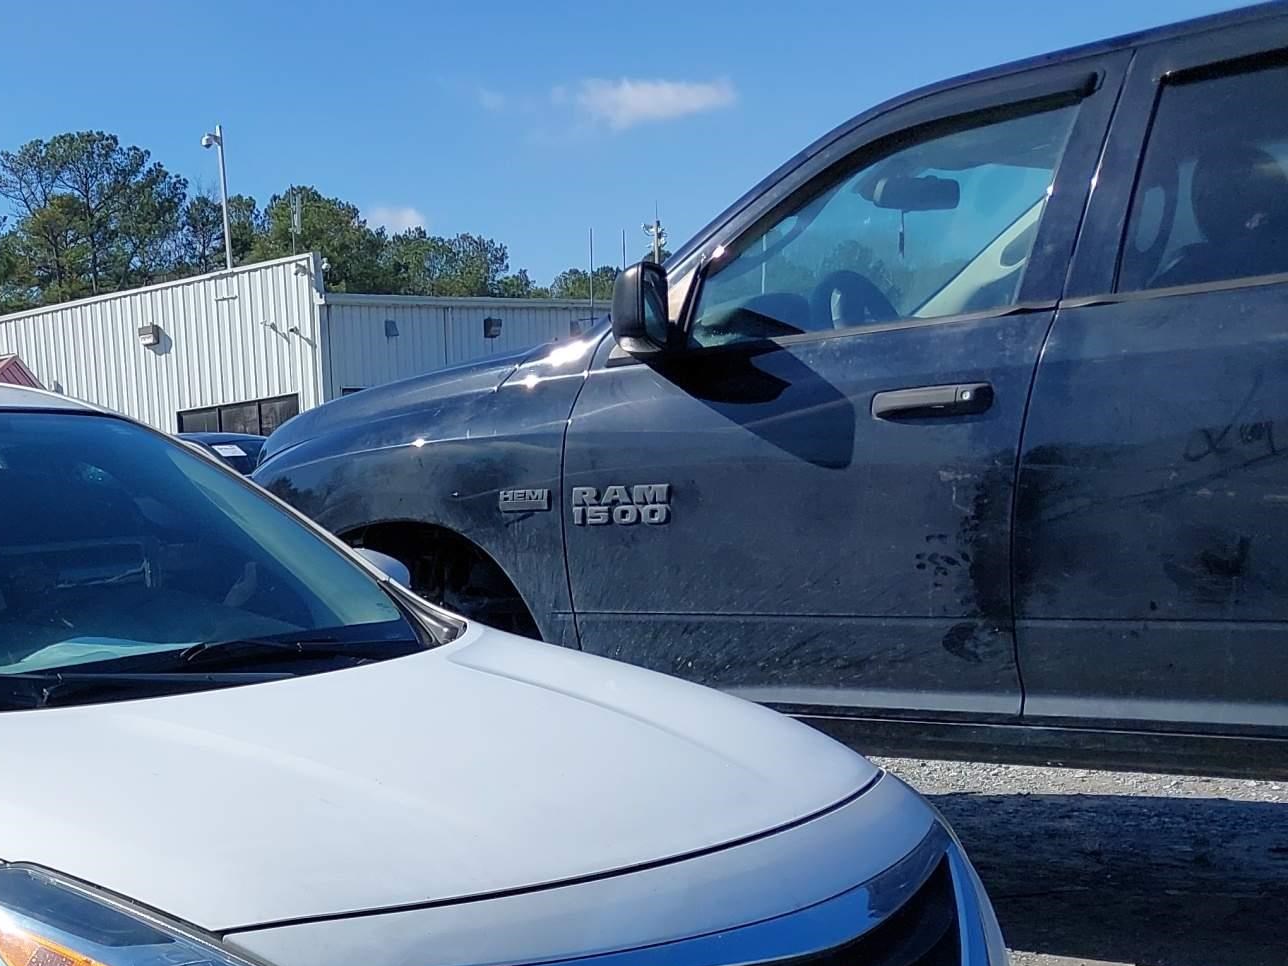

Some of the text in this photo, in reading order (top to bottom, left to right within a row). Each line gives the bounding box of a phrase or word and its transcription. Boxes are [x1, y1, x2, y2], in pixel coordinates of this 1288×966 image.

[500, 489, 548, 502] HEMI
[572, 484, 671, 505] RAM
[572, 505, 671, 525] 1500
